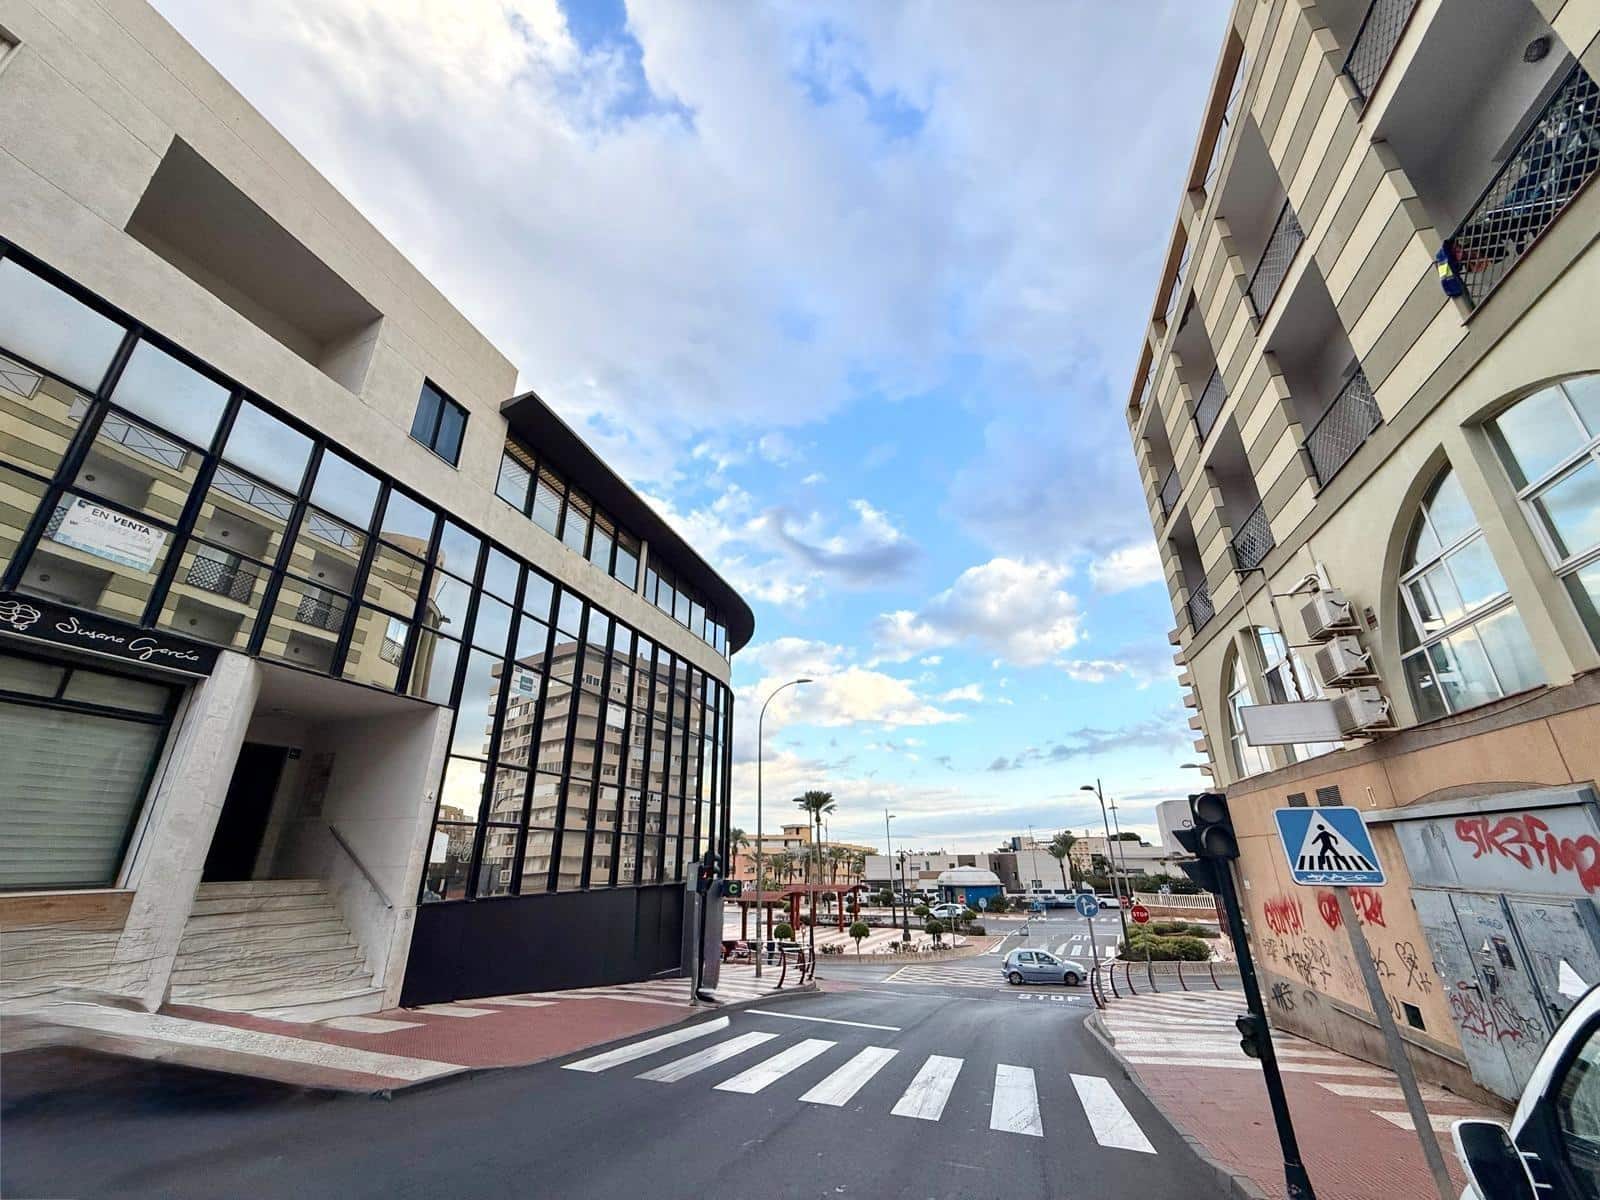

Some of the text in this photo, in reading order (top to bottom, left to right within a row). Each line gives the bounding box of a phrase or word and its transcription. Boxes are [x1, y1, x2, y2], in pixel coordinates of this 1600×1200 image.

[91, 508, 151, 536] EN VENTA
[55, 616, 125, 644] Susana
[1017, 993, 1081, 1002] STOP
